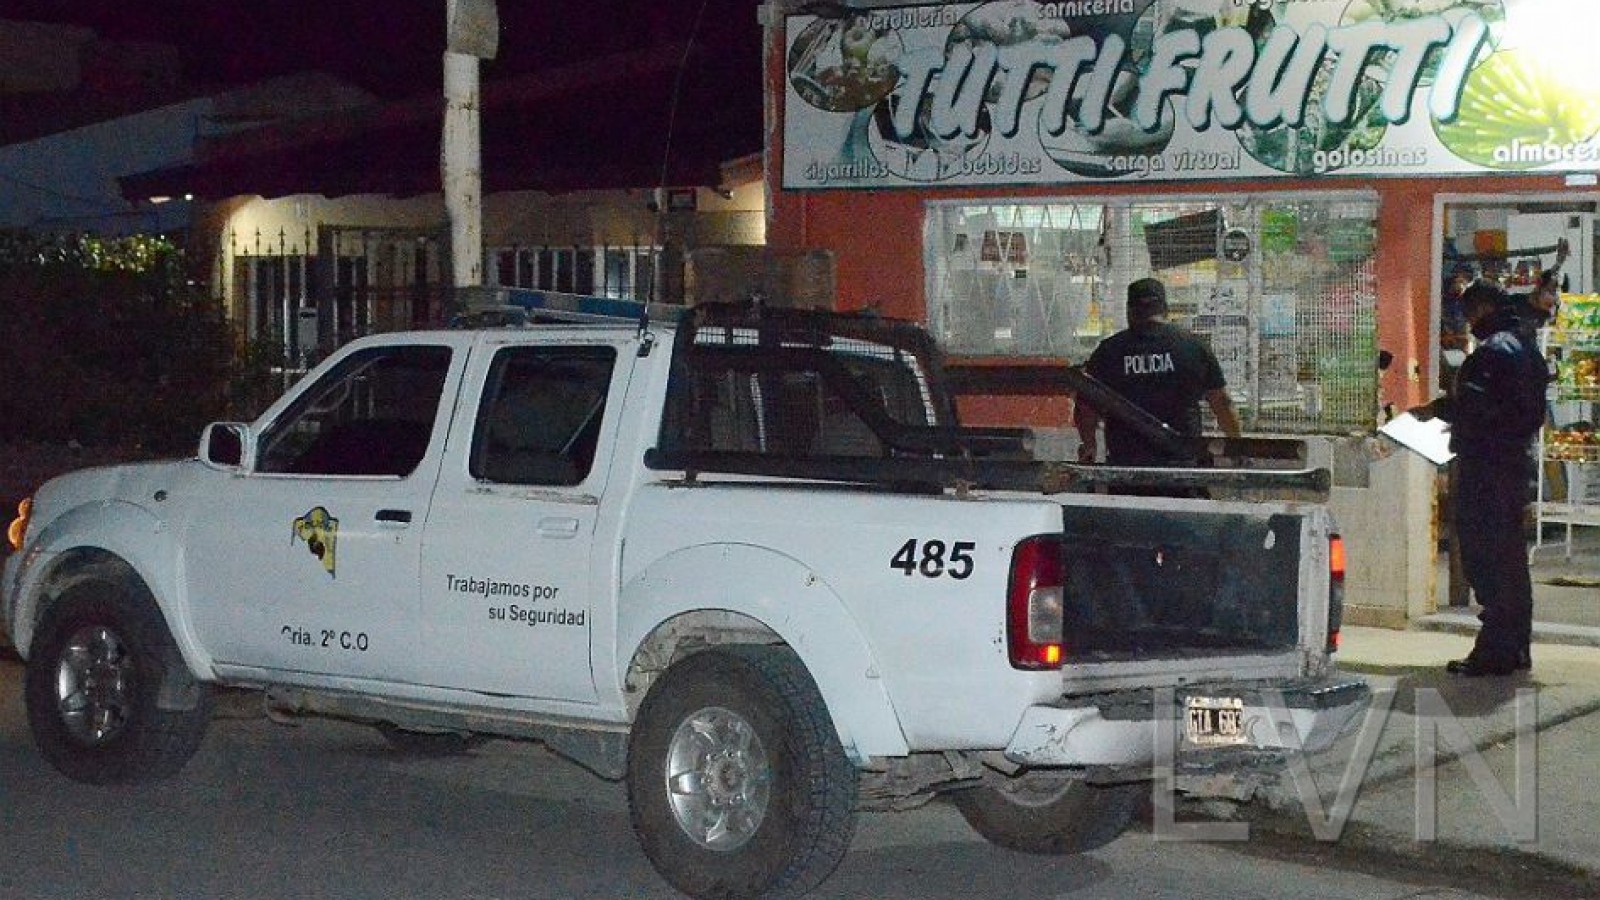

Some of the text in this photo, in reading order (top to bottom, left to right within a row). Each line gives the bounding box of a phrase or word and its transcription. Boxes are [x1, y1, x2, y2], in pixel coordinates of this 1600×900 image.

[888, 14, 1488, 140] TUTTI FRUTTI
[803, 155, 890, 183] cigarrillos
[961, 152, 1042, 175] bebidas
[1105, 148, 1241, 177] carga virtual
[1313, 143, 1427, 173] golosinas
[1123, 353, 1175, 375] POLICIA
[890, 538, 976, 580] 485
[446, 574, 559, 602] Trabajamos por
[488, 604, 585, 627] su Seguridad
